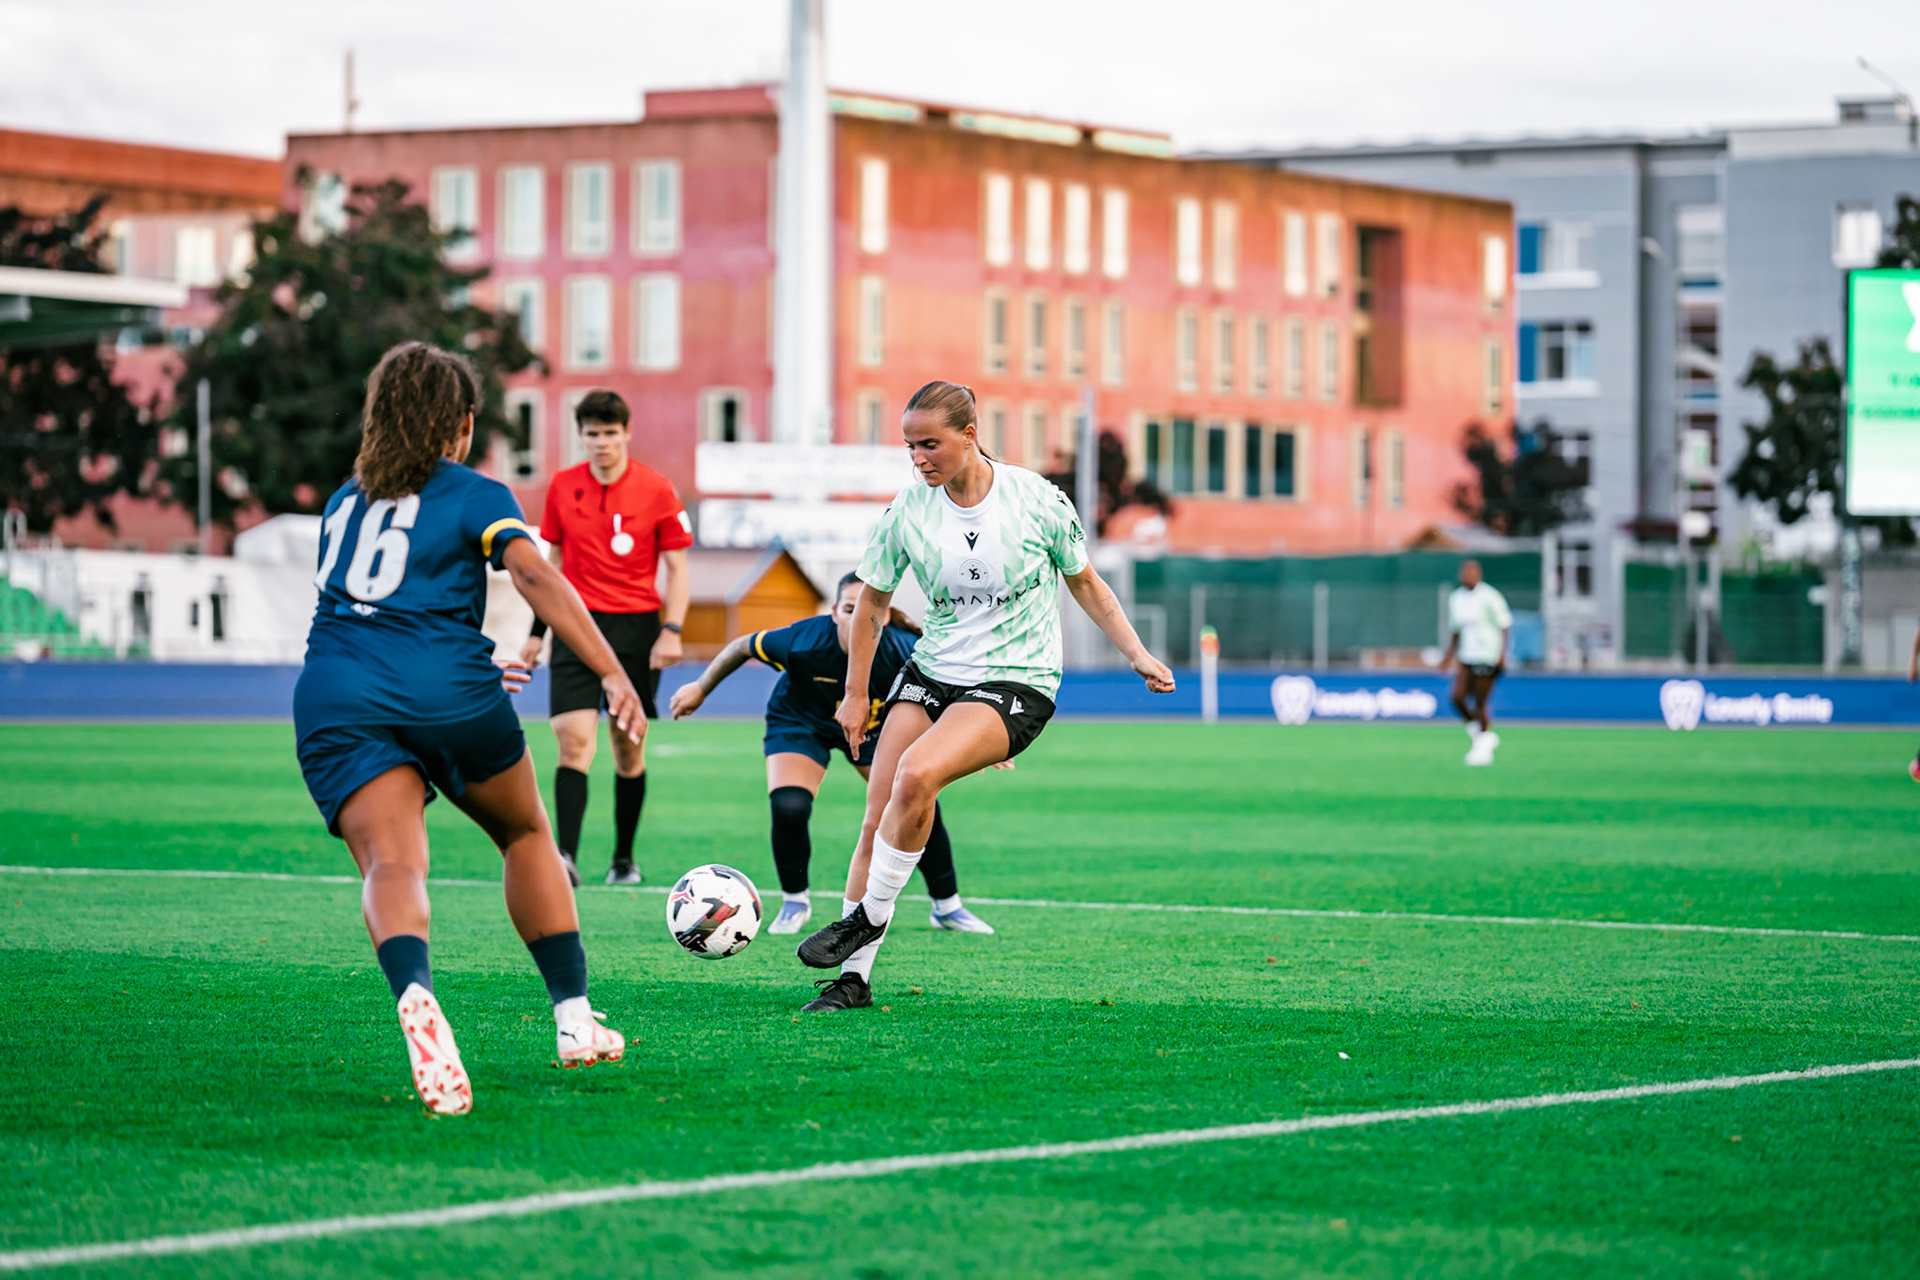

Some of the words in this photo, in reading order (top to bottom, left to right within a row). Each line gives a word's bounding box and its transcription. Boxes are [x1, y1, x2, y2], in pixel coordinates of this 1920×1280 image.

[314, 493, 420, 602] 16
[1314, 688, 1377, 720] Lovely
[1377, 687, 1437, 718] Smile
[1704, 692, 1772, 726] Lovely
[1773, 692, 1833, 723] Smile
